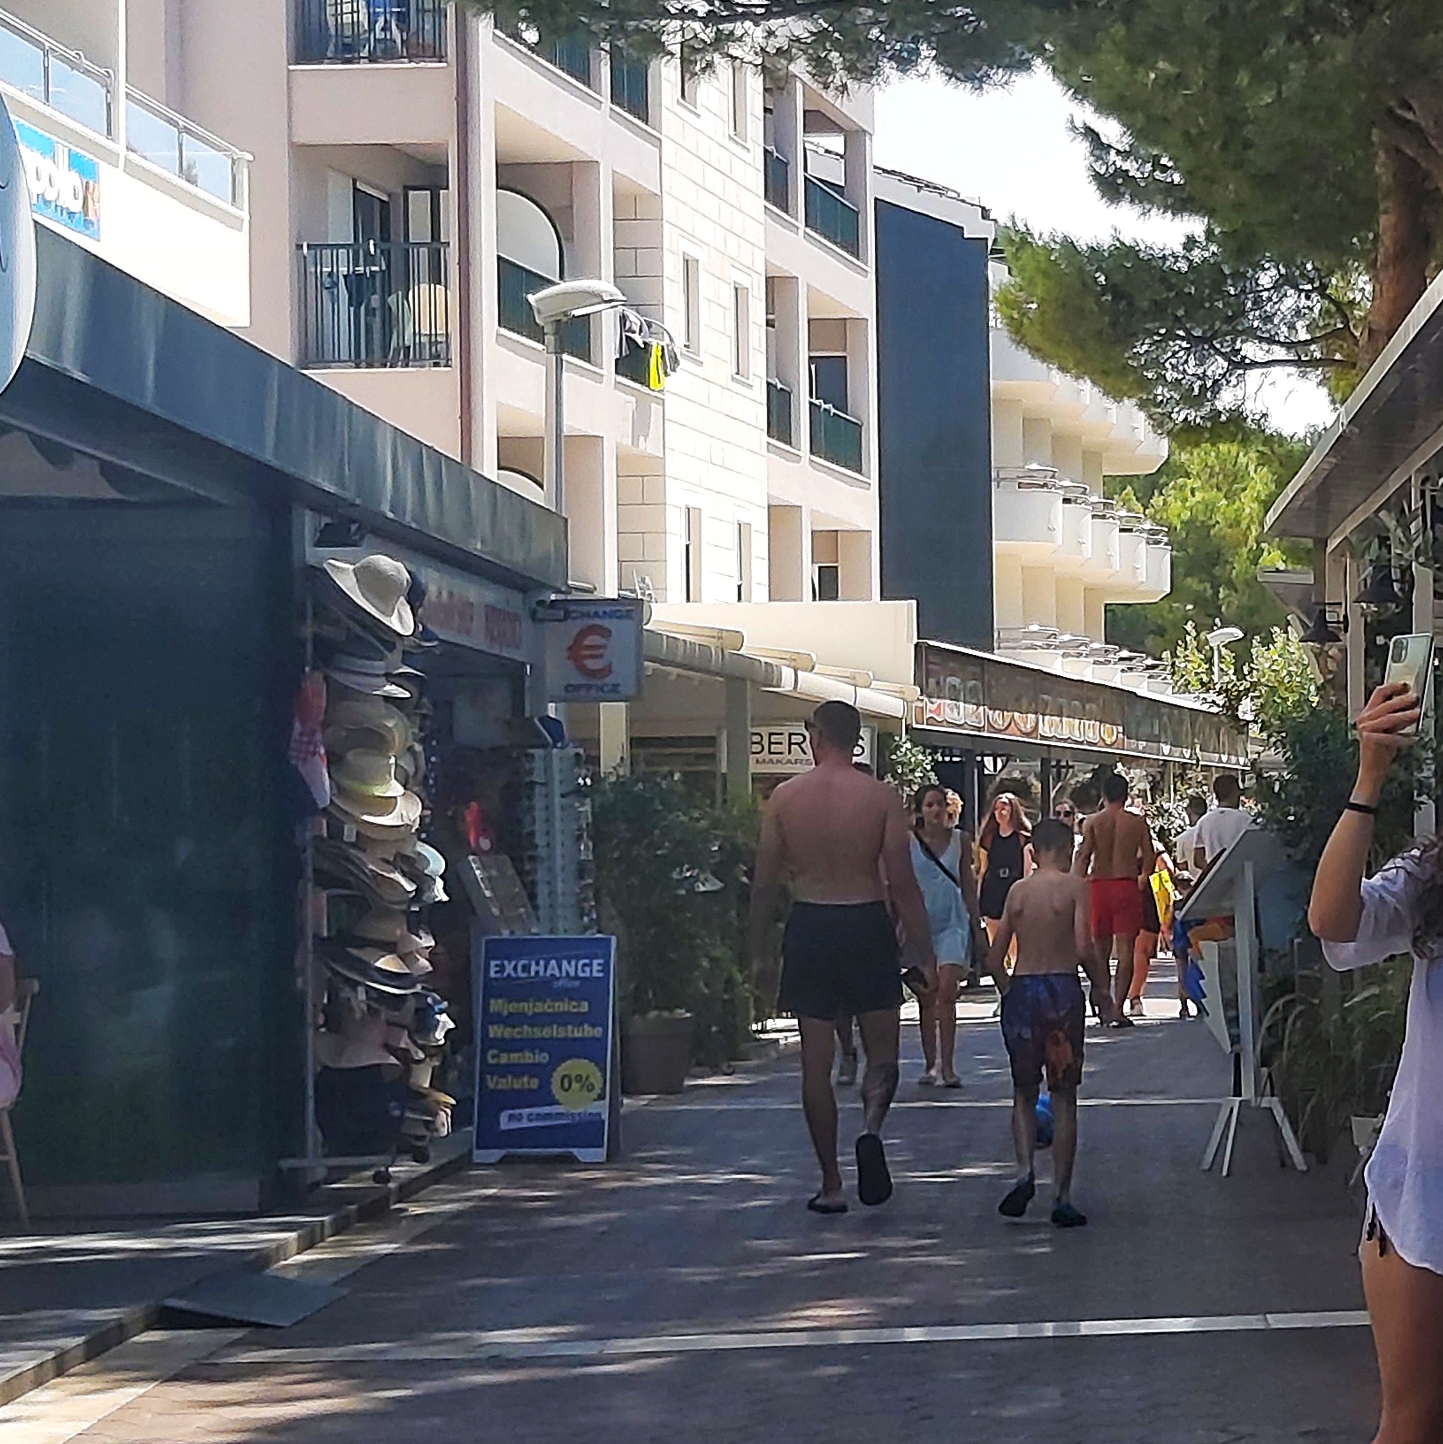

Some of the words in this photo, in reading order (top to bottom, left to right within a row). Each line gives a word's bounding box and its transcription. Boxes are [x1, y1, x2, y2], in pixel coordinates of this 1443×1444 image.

[568, 608, 635, 620] CHANGE
[564, 683, 622, 694] OFFICE
[489, 959, 605, 978] EXCHANGE
[488, 1023, 604, 1039] Wechselstube
[486, 1048, 550, 1065] Cambio
[486, 1074, 539, 1090] Valute
[560, 1073, 596, 1093] 0%
